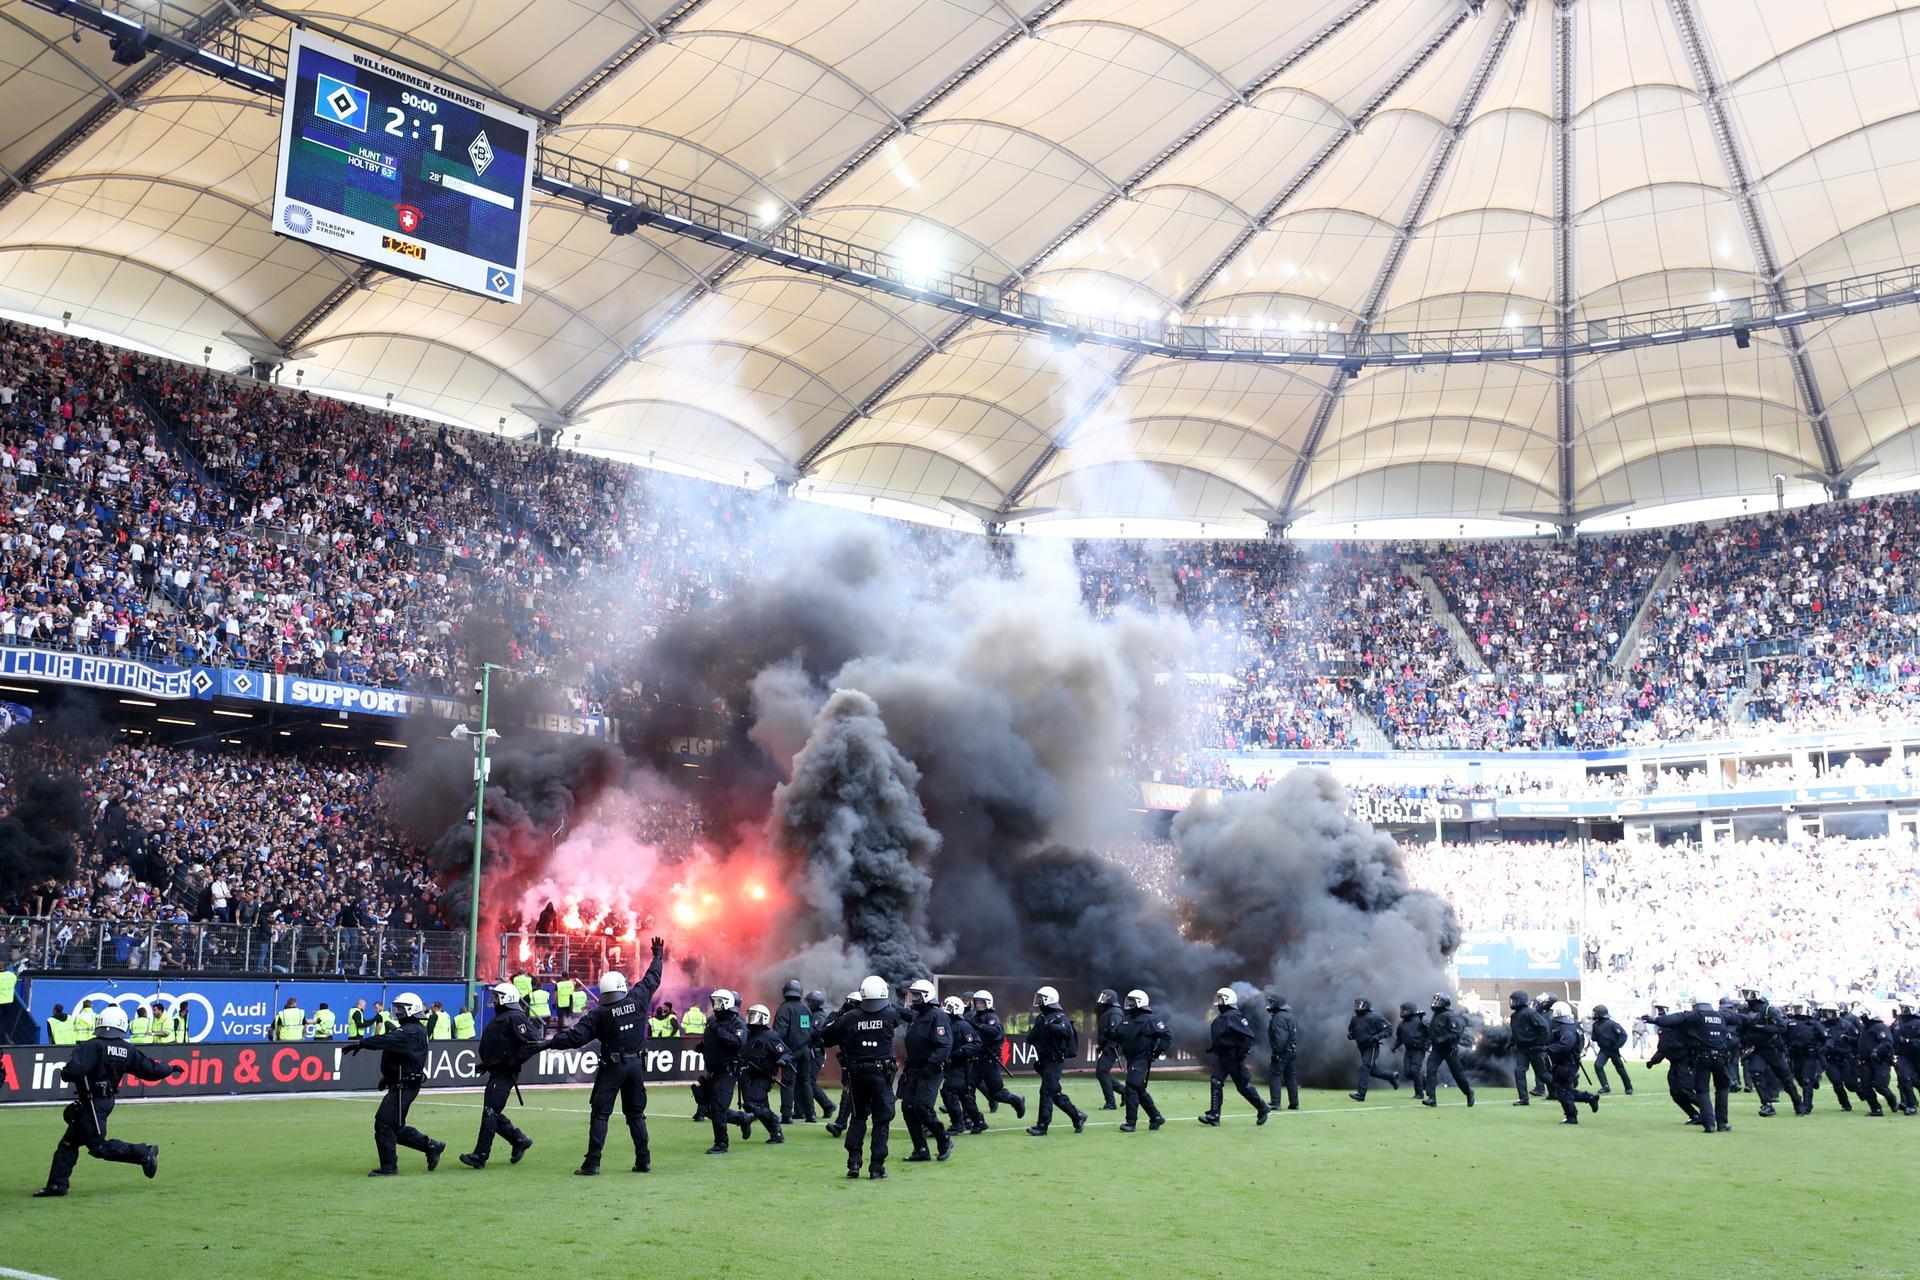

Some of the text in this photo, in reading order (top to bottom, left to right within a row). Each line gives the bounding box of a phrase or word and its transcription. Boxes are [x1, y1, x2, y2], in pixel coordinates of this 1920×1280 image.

[353, 54, 485, 111] WILLKOMMEN ZUHAUSE!
[402, 92, 437, 114] 90:00
[359, 147, 381, 161] HUNT
[348, 156, 380, 173] HOLTBY
[316, 226, 345, 238] STADION
[317, 220, 355, 235] VOLKSPARK
[15, 651, 74, 679] CLUB
[81, 659, 191, 695] ROTHOSEN
[292, 681, 425, 714] SUPPORTE
[221, 1001, 266, 1017] Audi
[612, 1003, 636, 1017] POLIZEI
[858, 1020, 883, 1031] POLIZEI
[107, 1046, 127, 1058] POLIZEI
[233, 1049, 261, 1084] &
